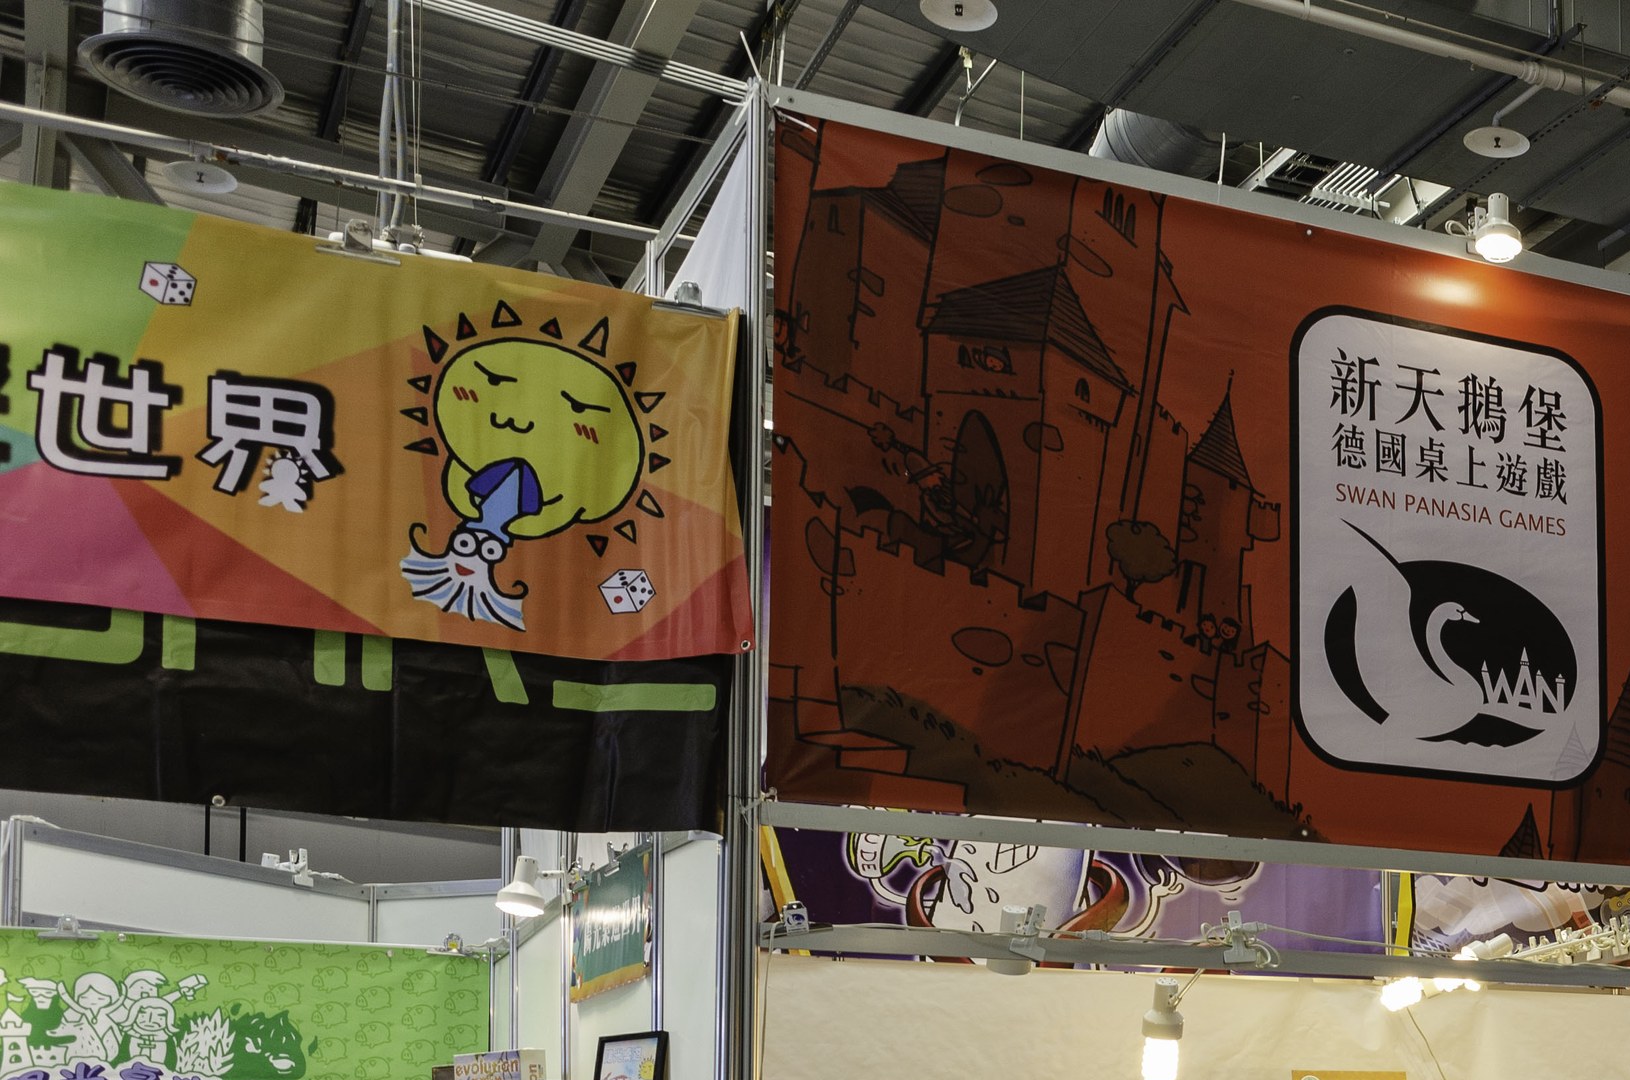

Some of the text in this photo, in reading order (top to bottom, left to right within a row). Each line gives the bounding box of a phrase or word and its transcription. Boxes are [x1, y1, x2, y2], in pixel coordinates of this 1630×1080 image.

[29, 346, 344, 500] 世界
[1330, 347, 1569, 454] 新天鵝堡
[1331, 422, 1569, 506] 德國桌上遊戲
[1336, 483, 1567, 537] SWAN PANASIA GAMES
[455, 1058, 521, 1078] evolution
